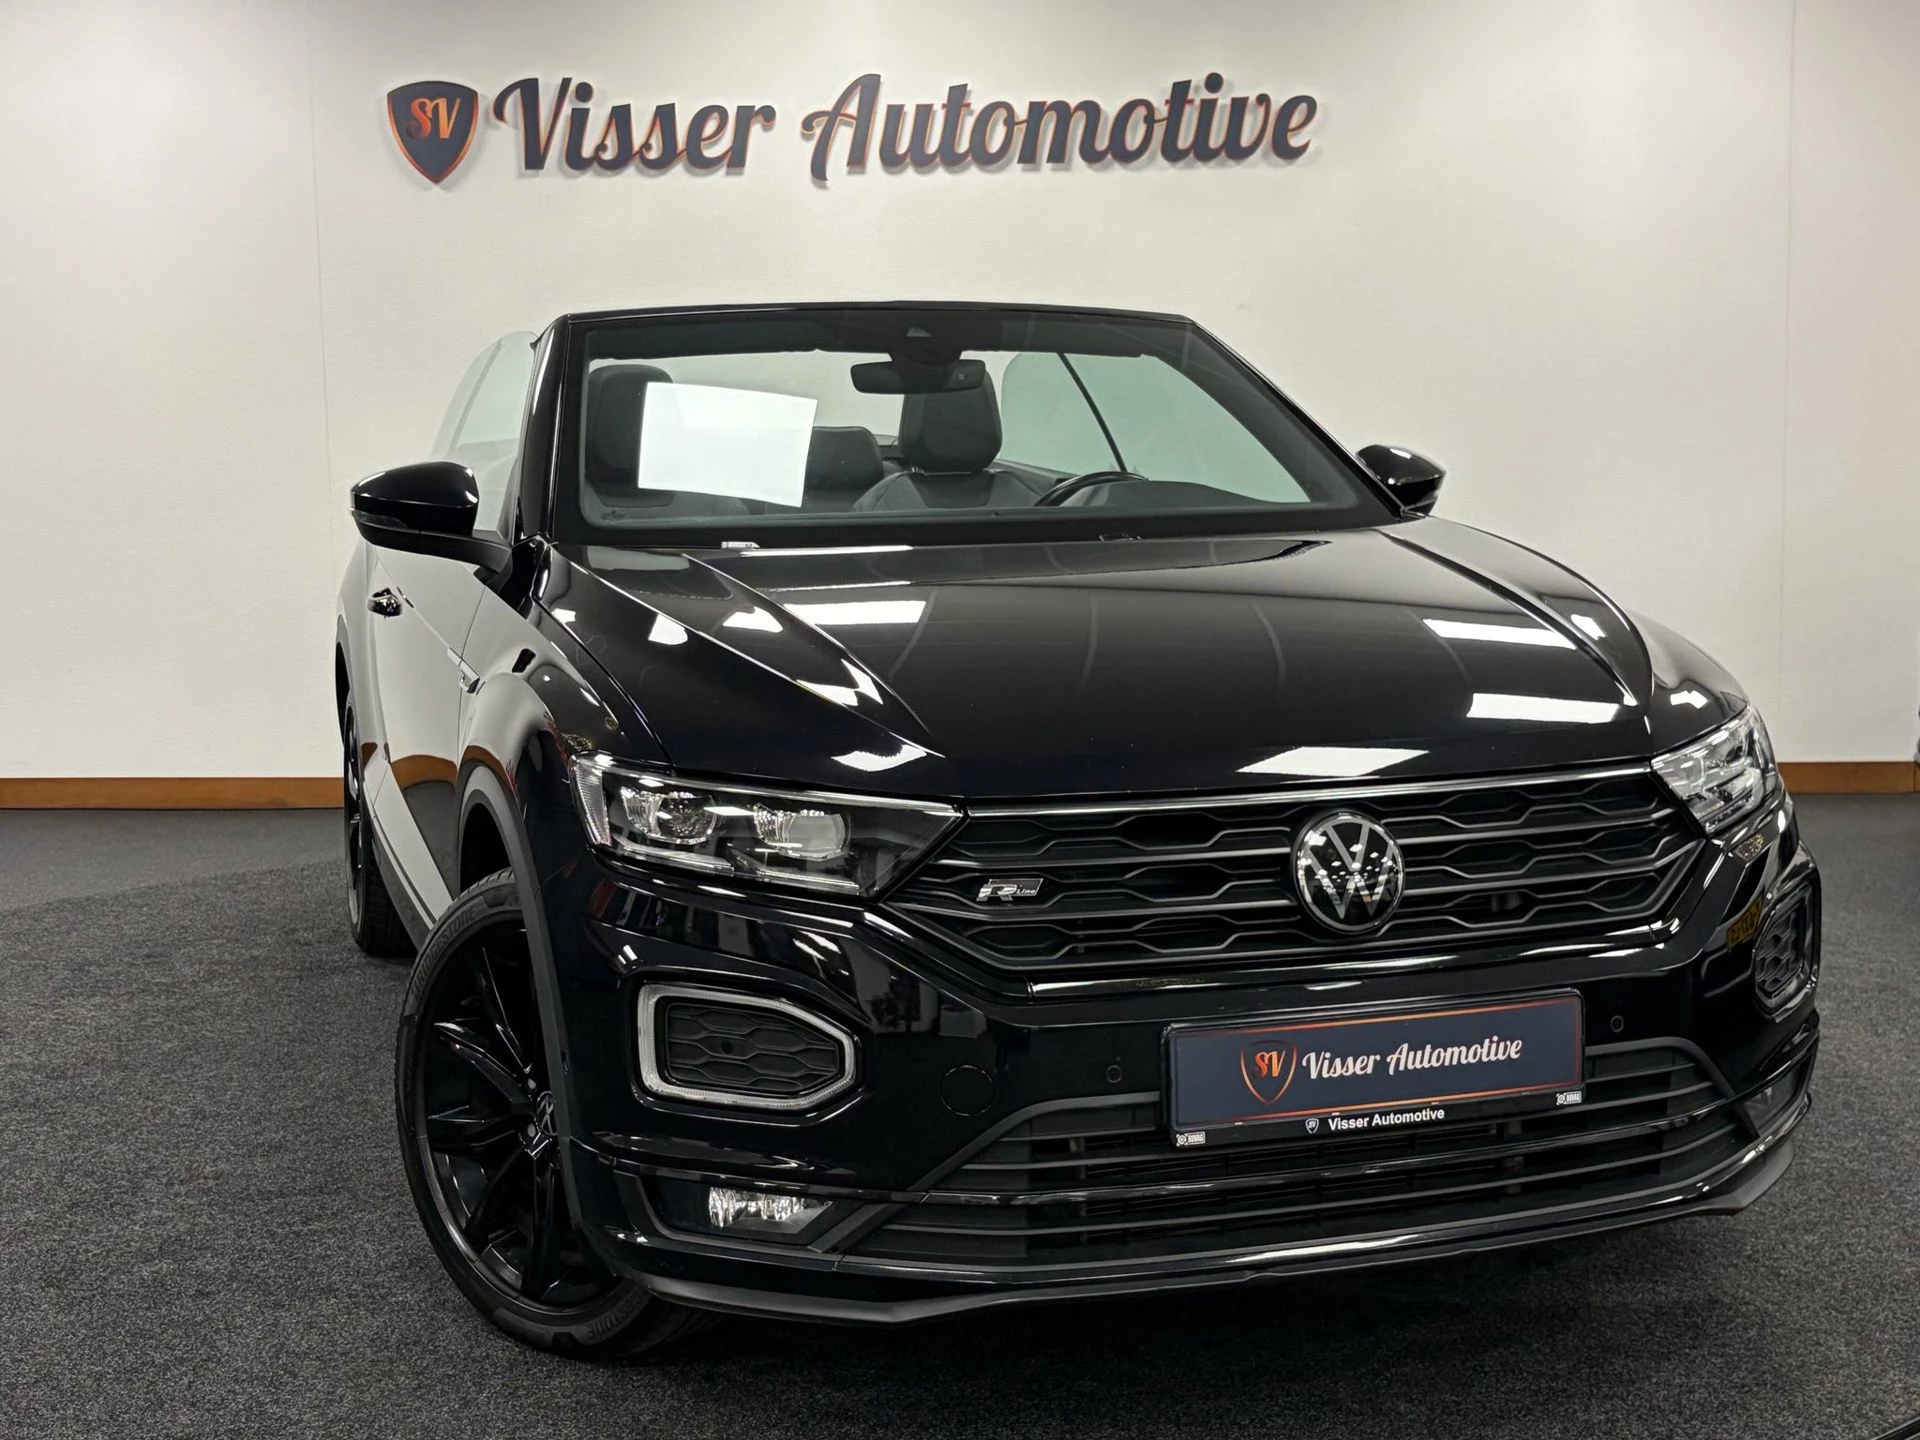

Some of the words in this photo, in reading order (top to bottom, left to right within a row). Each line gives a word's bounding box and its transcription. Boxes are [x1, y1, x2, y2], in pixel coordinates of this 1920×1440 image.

[405, 97, 461, 140] SV
[492, 77, 777, 171] Visser
[800, 72, 1319, 182] Automotive
[1253, 1050, 1286, 1078] SV
[1302, 1051, 1380, 1079] Visser
[1386, 1035, 1522, 1075] Automotive
[1328, 1117, 1370, 1131] Visser
[1373, 1108, 1445, 1126] Automotive
